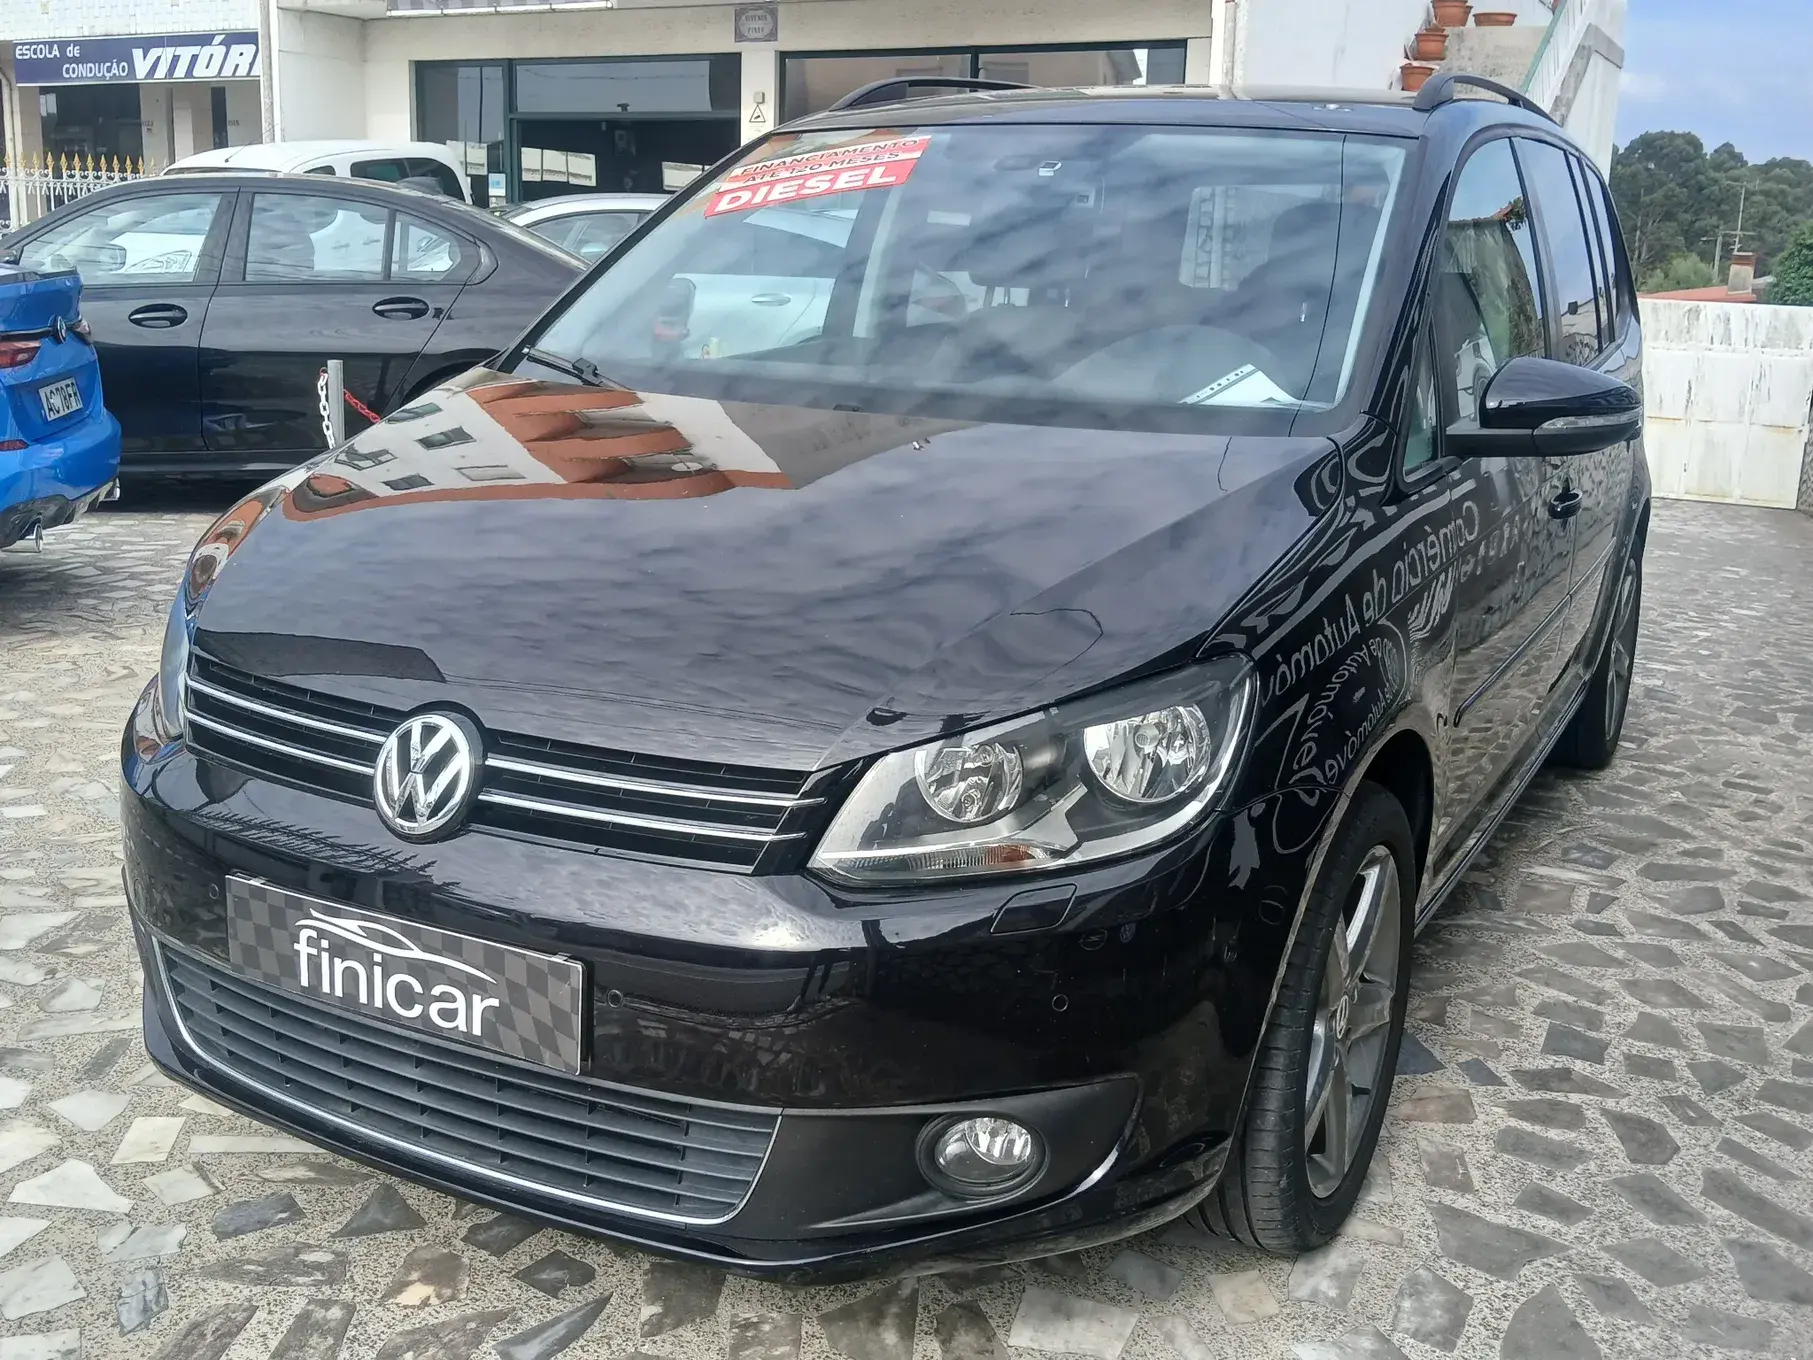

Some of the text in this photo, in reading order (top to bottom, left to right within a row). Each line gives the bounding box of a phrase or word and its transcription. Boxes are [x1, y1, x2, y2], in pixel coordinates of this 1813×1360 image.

[15, 43, 80, 60] ESCOLA de
[62, 59, 128, 80] CONDUÇÃO
[741, 139, 918, 175] FINANCIAMENTO
[789, 163, 822, 175] 120
[829, 151, 900, 168] MESES
[714, 165, 896, 212] DIESEL
[293, 927, 500, 1037] finicar
